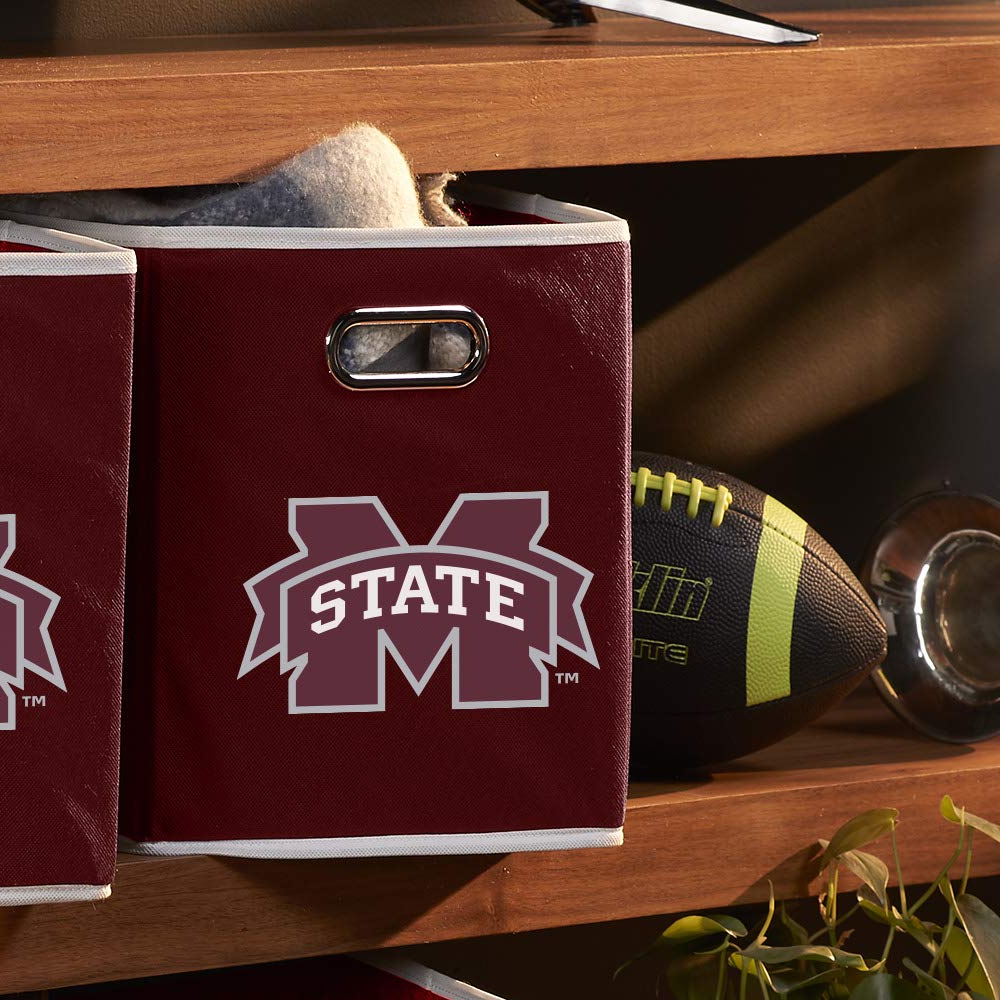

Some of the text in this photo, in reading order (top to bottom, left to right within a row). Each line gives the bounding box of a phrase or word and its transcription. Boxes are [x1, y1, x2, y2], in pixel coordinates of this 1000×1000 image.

[311, 565, 524, 634] STATE
[555, 672, 579, 684] TM
[22, 696, 46, 707] TM
